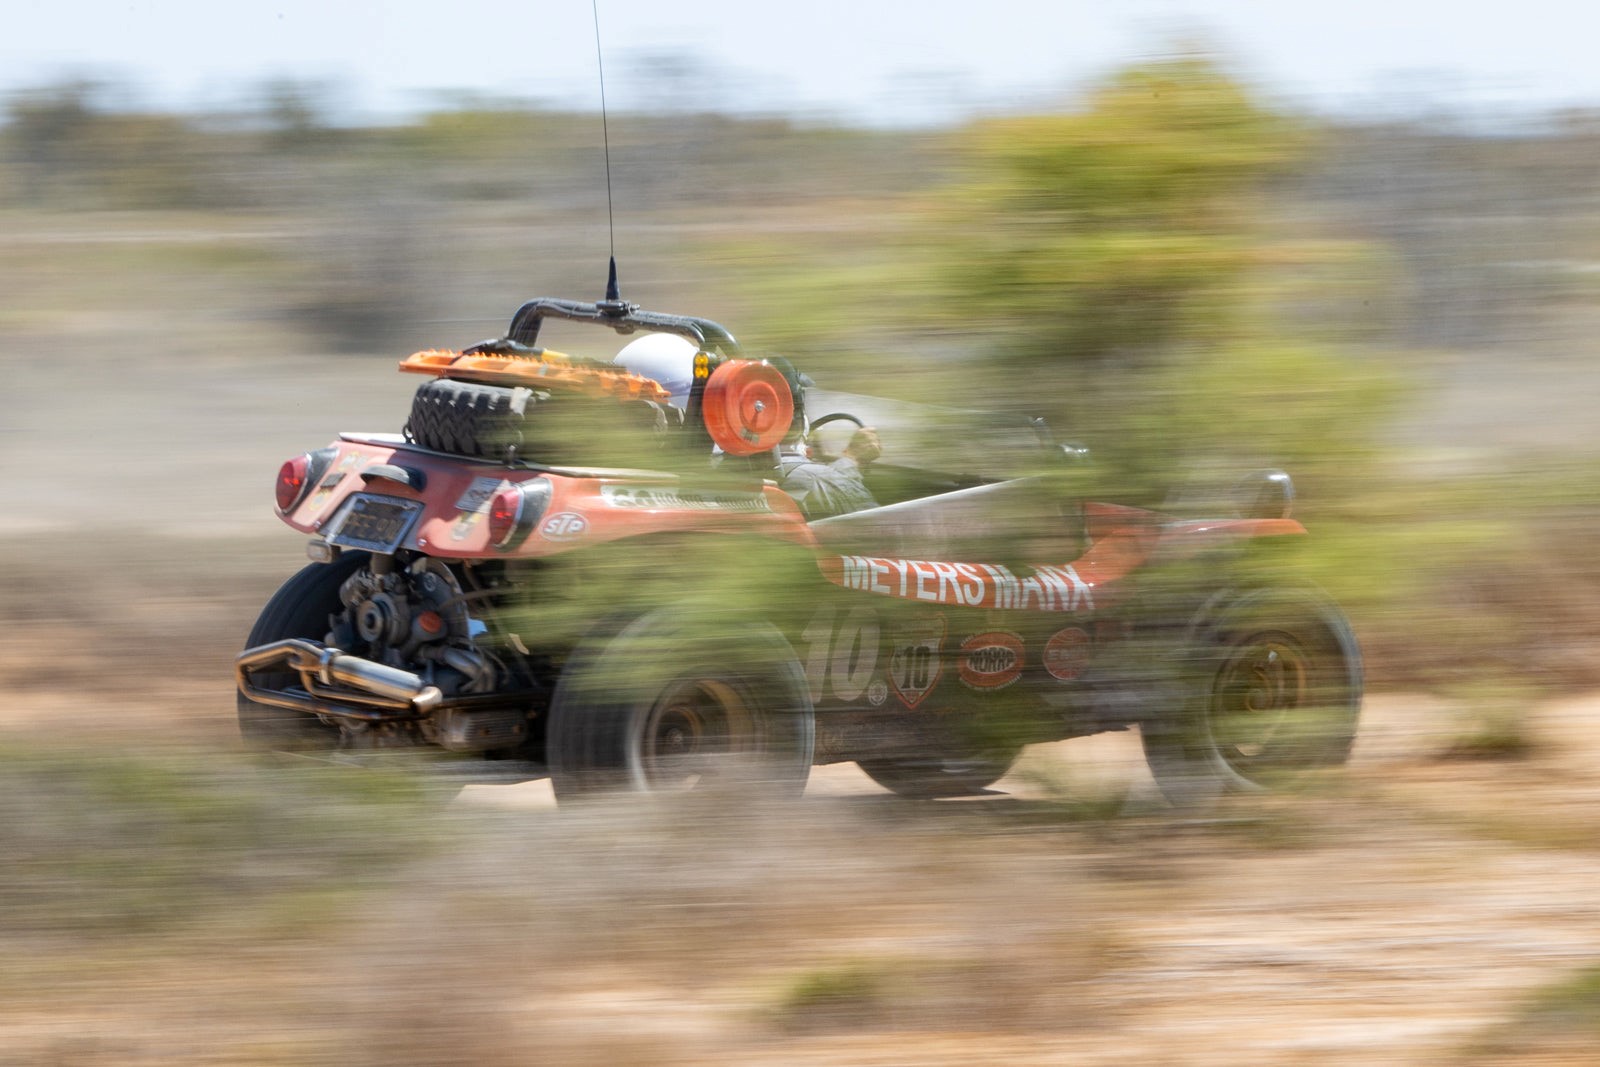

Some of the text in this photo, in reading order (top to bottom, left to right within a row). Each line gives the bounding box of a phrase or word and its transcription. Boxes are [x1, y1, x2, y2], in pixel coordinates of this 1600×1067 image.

[543, 514, 585, 536] STP
[841, 555, 1095, 612] MEYERS MANX
[801, 602, 881, 704] 10
[901, 646, 931, 689] 10
